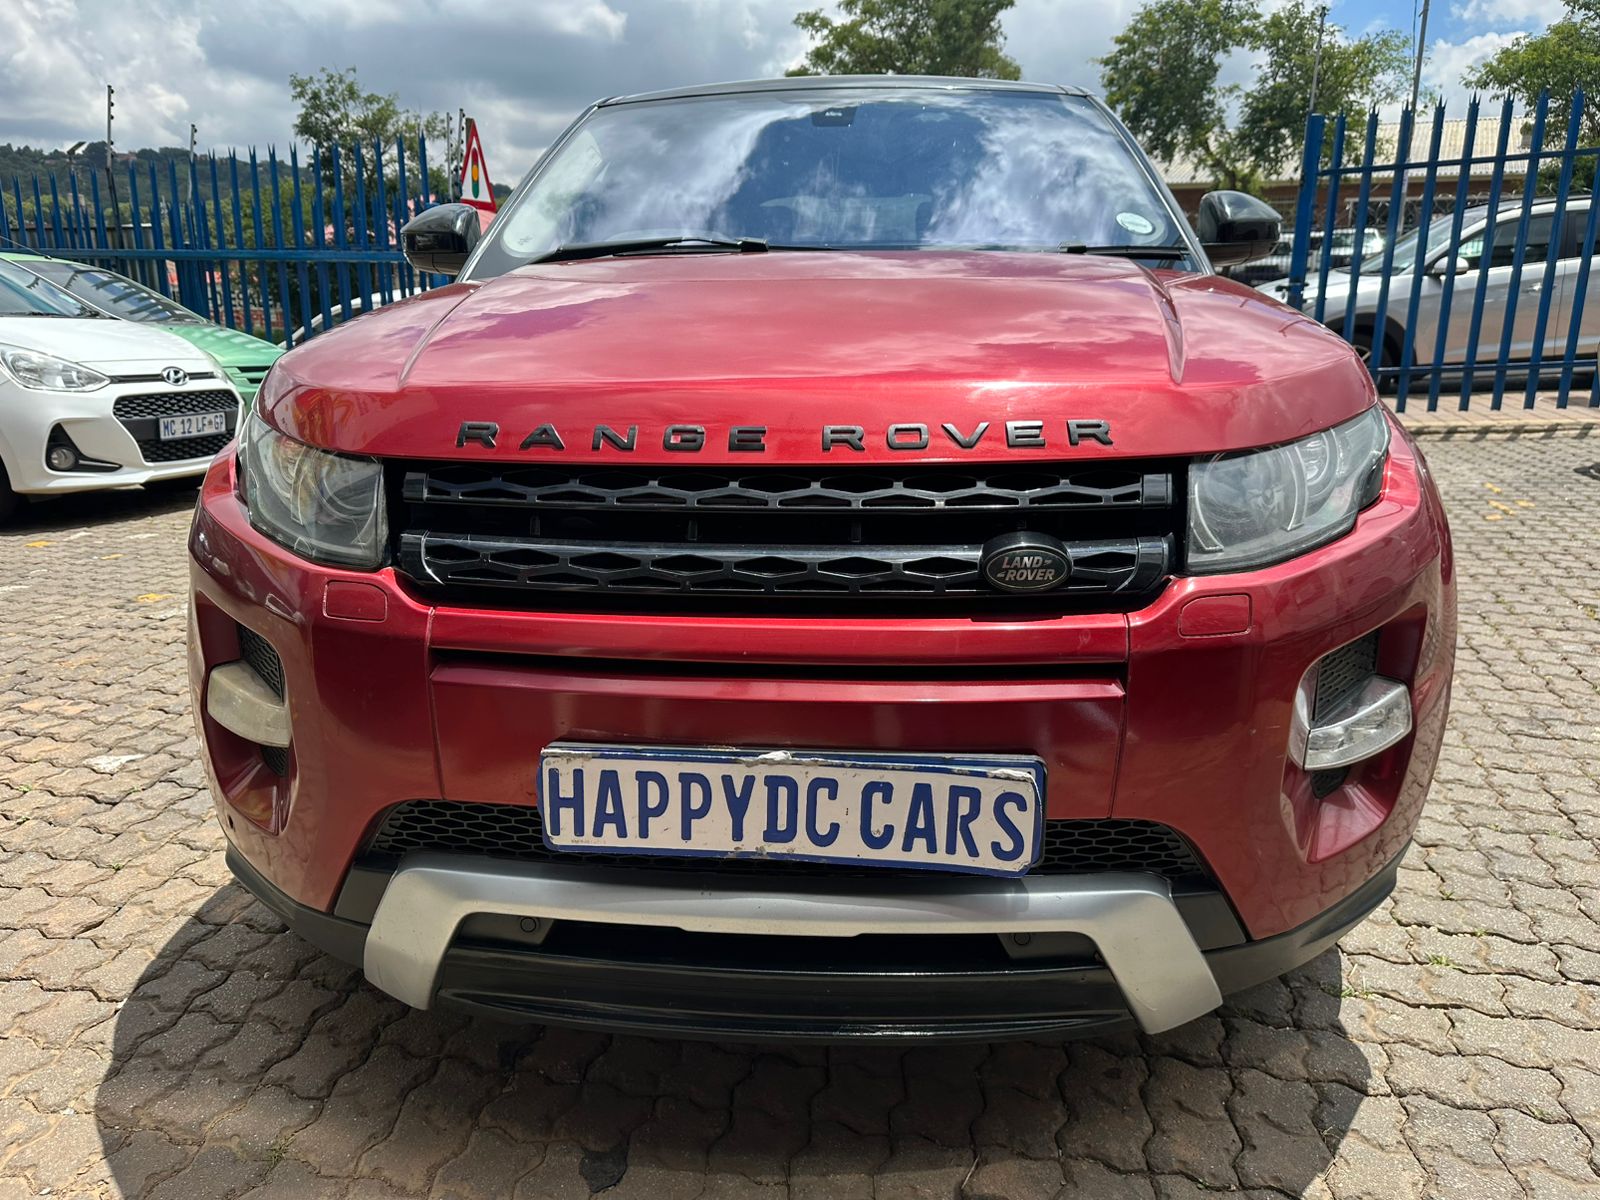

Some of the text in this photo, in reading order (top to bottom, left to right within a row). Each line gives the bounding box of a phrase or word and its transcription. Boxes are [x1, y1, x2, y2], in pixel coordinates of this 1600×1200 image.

[163, 414, 224, 437] MC 12 LF GP
[456, 419, 1113, 451] RANGE ROVER
[1002, 556, 1043, 569] LAND
[1005, 569, 1055, 581] ROVER
[548, 768, 1028, 861] HAPPYDC CARS
